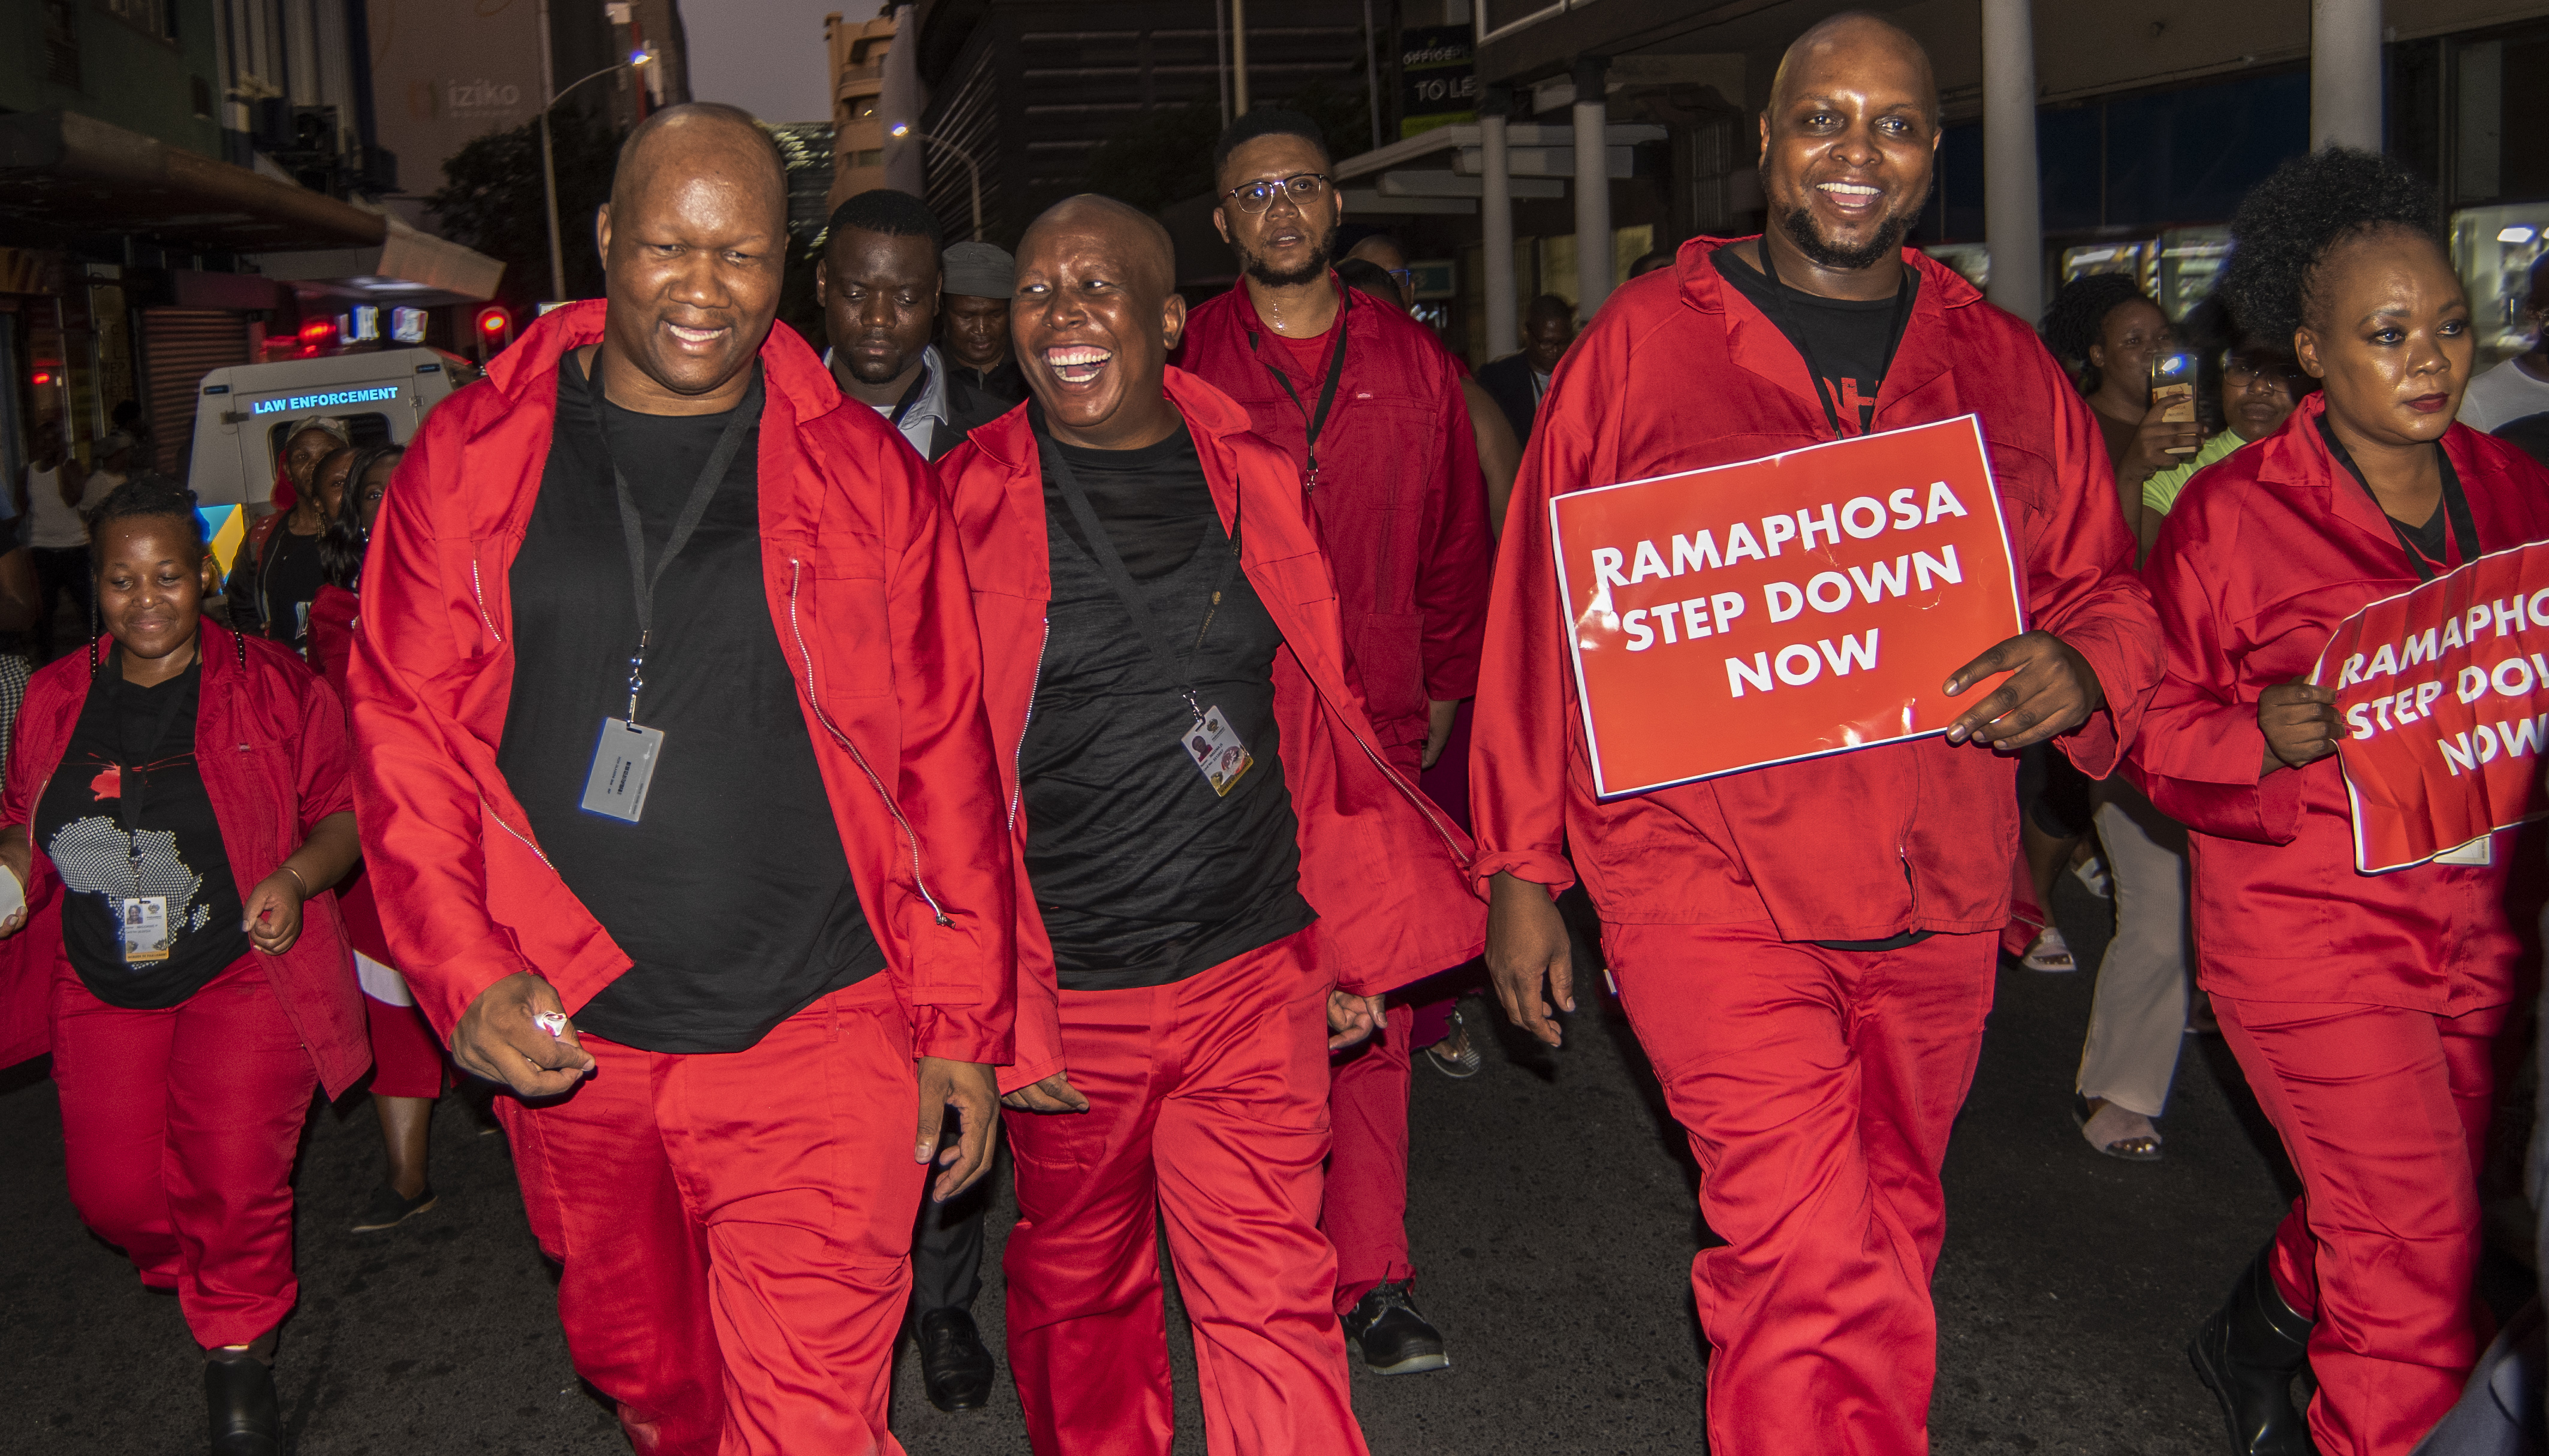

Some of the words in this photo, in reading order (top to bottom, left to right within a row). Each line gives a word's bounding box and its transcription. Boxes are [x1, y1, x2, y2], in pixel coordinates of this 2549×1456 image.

[448, 79, 520, 108] iziko
[1414, 78, 1447, 101] TO
[1449, 75, 1477, 99] LE
[254, 399, 286, 414] LAW
[290, 387, 397, 409] ENFORCEMENT
[1592, 481, 1968, 588] RAMAPHOSA
[1622, 592, 1744, 652] STEP
[1764, 545, 1962, 623] DOWN
[1725, 628, 1878, 698] NOW
[2338, 587, 2549, 691] RAMAPHO
[2346, 680, 2442, 740] STEP
[2437, 712, 2547, 776] NOW
